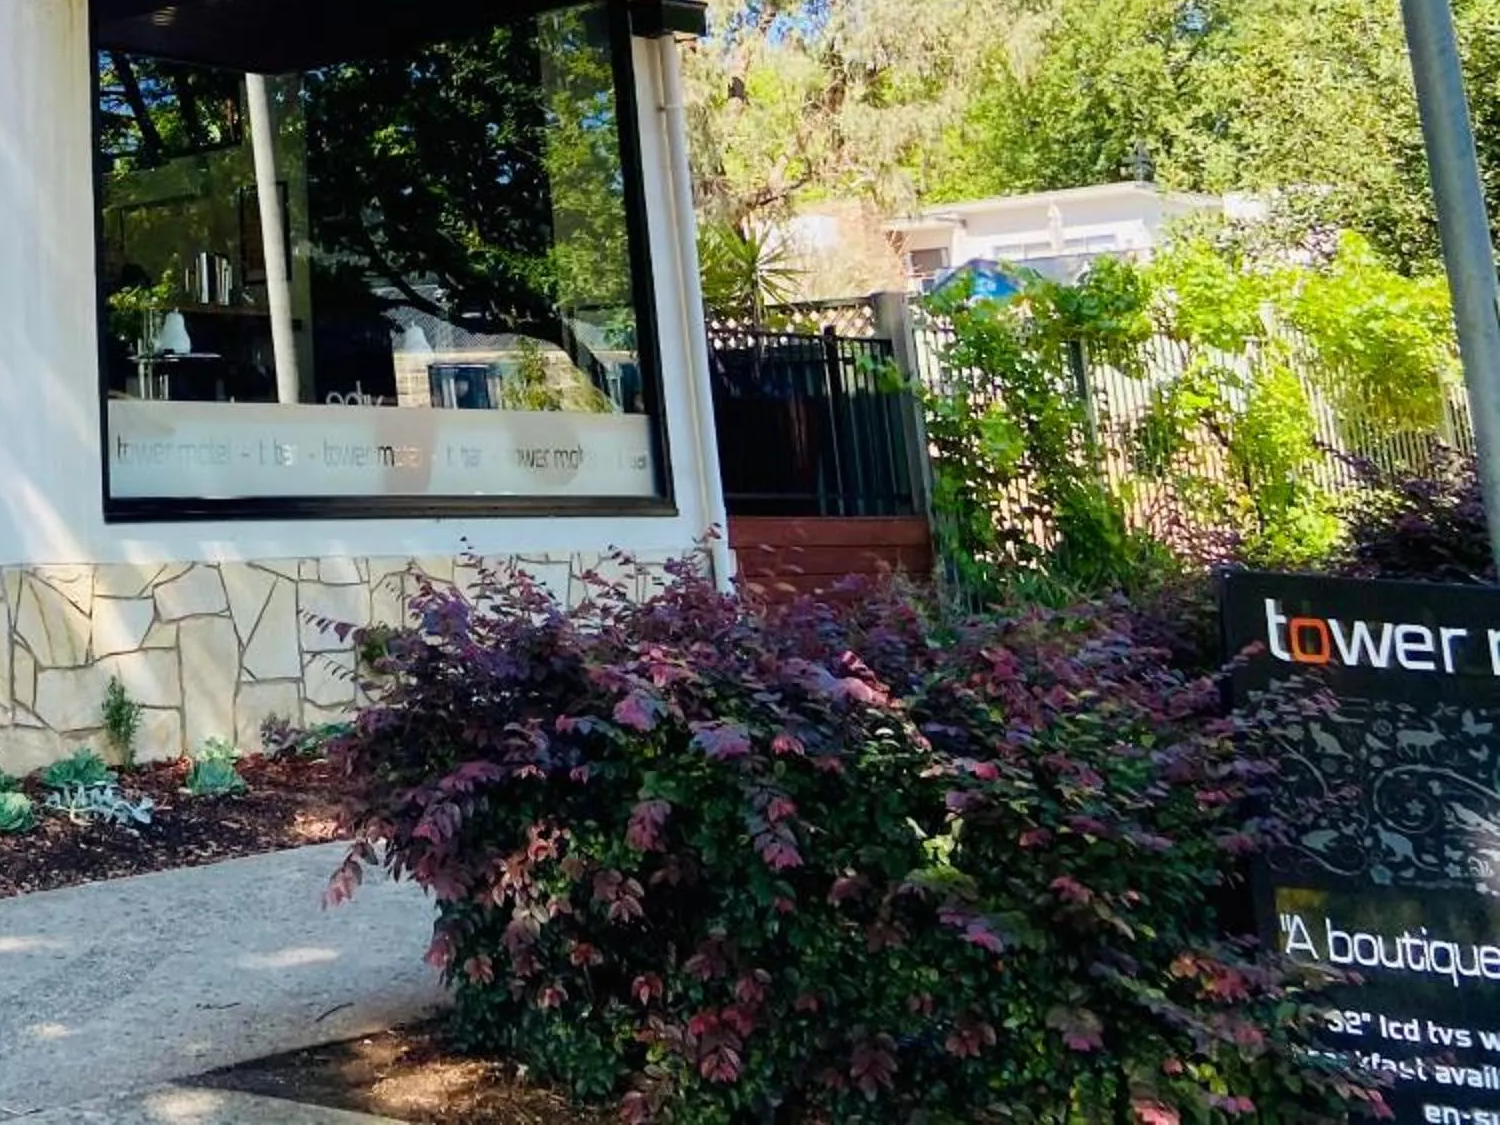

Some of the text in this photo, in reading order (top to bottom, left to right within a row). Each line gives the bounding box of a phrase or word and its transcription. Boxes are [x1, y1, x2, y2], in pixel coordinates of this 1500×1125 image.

[1264, 597, 1468, 674] tower
[1325, 917, 1500, 988] boutique
[1380, 1014, 1421, 1042] lcd
[1427, 1020, 1473, 1048] tvs
